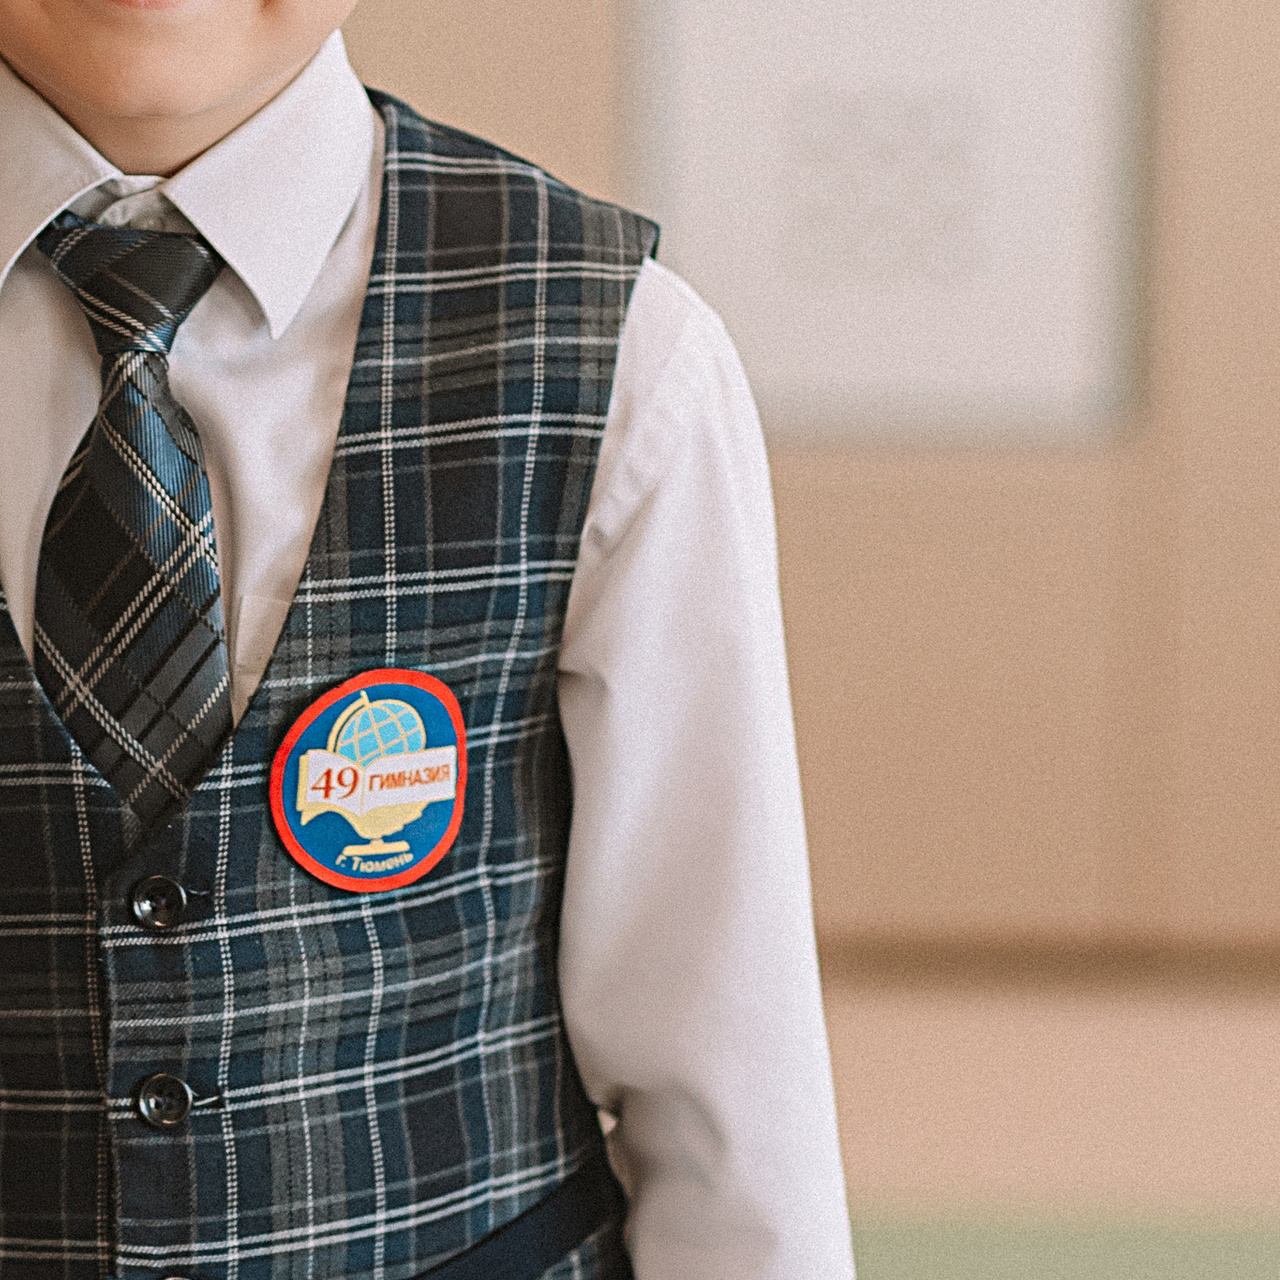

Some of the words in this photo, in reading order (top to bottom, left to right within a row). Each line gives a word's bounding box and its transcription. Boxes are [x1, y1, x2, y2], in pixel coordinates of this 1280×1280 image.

[311, 767, 360, 800] 49
[368, 764, 452, 792] ГИМНАЗИЯ
[336, 855, 346, 867] г.
[352, 853, 414, 872] Тюмень
